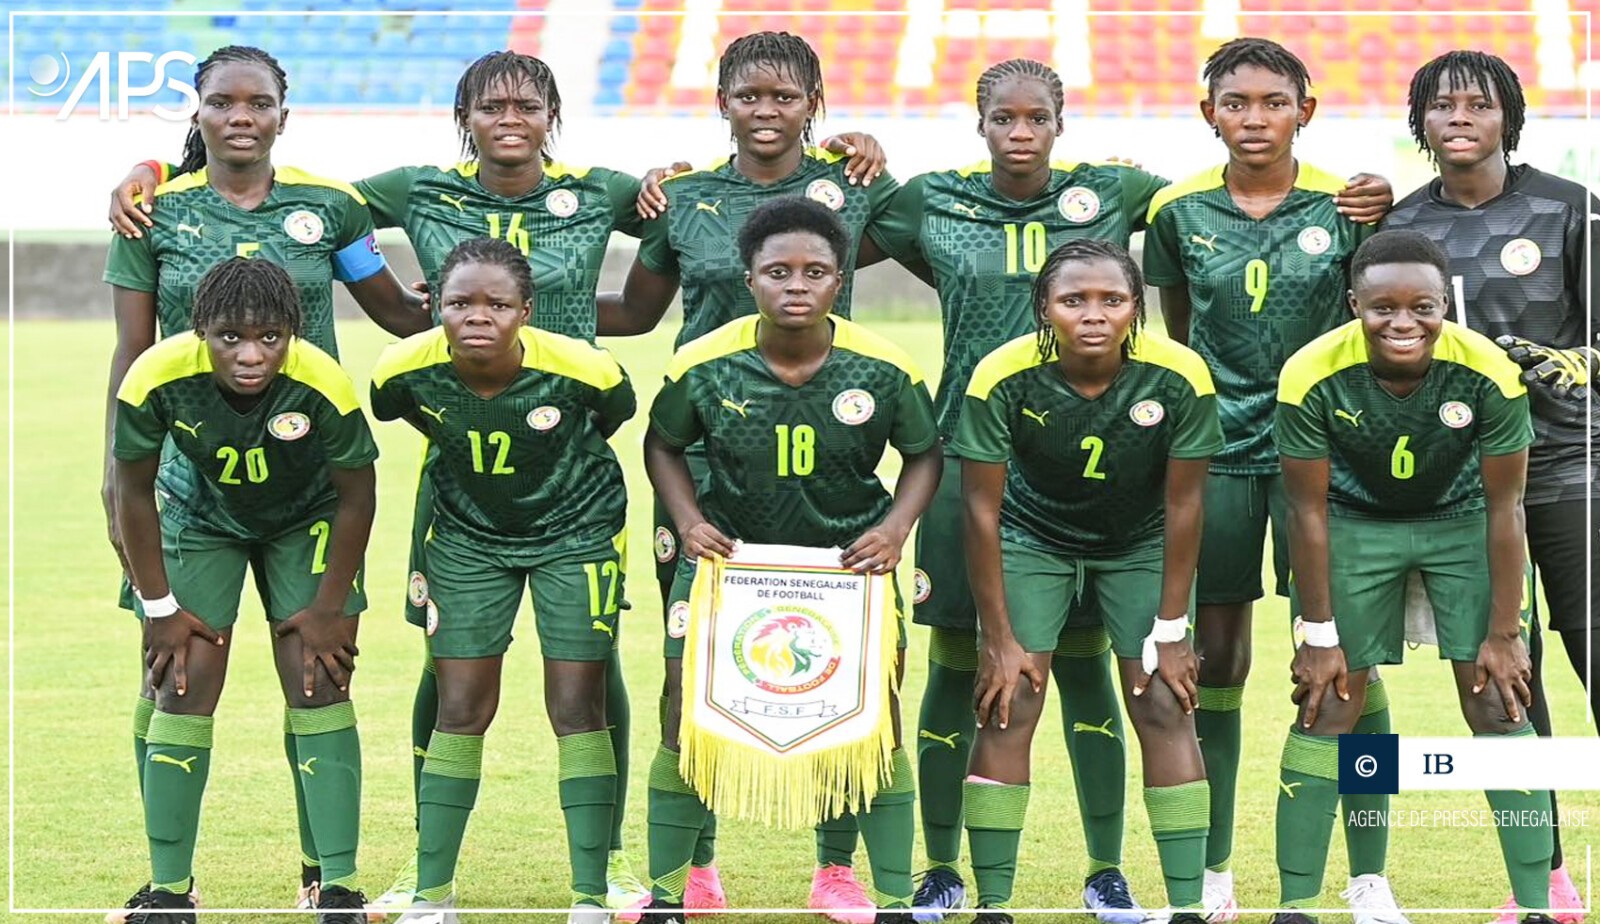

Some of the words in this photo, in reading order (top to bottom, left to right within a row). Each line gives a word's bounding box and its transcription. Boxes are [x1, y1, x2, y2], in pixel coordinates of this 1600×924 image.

[1003, 222, 1047, 275] 10
[1245, 259, 1268, 312] 9
[216, 446, 269, 485] 20
[467, 430, 515, 475] 12
[776, 424, 815, 477] 18
[1080, 435, 1106, 480] 2
[1391, 435, 1415, 479] 6
[309, 520, 330, 575] 2
[583, 560, 618, 617] 12
[724, 575, 787, 588] FEDERATION
[790, 578, 859, 590] SENEGALAISE
[757, 589, 770, 598] DE
[773, 590, 825, 601] FOOTBALL
